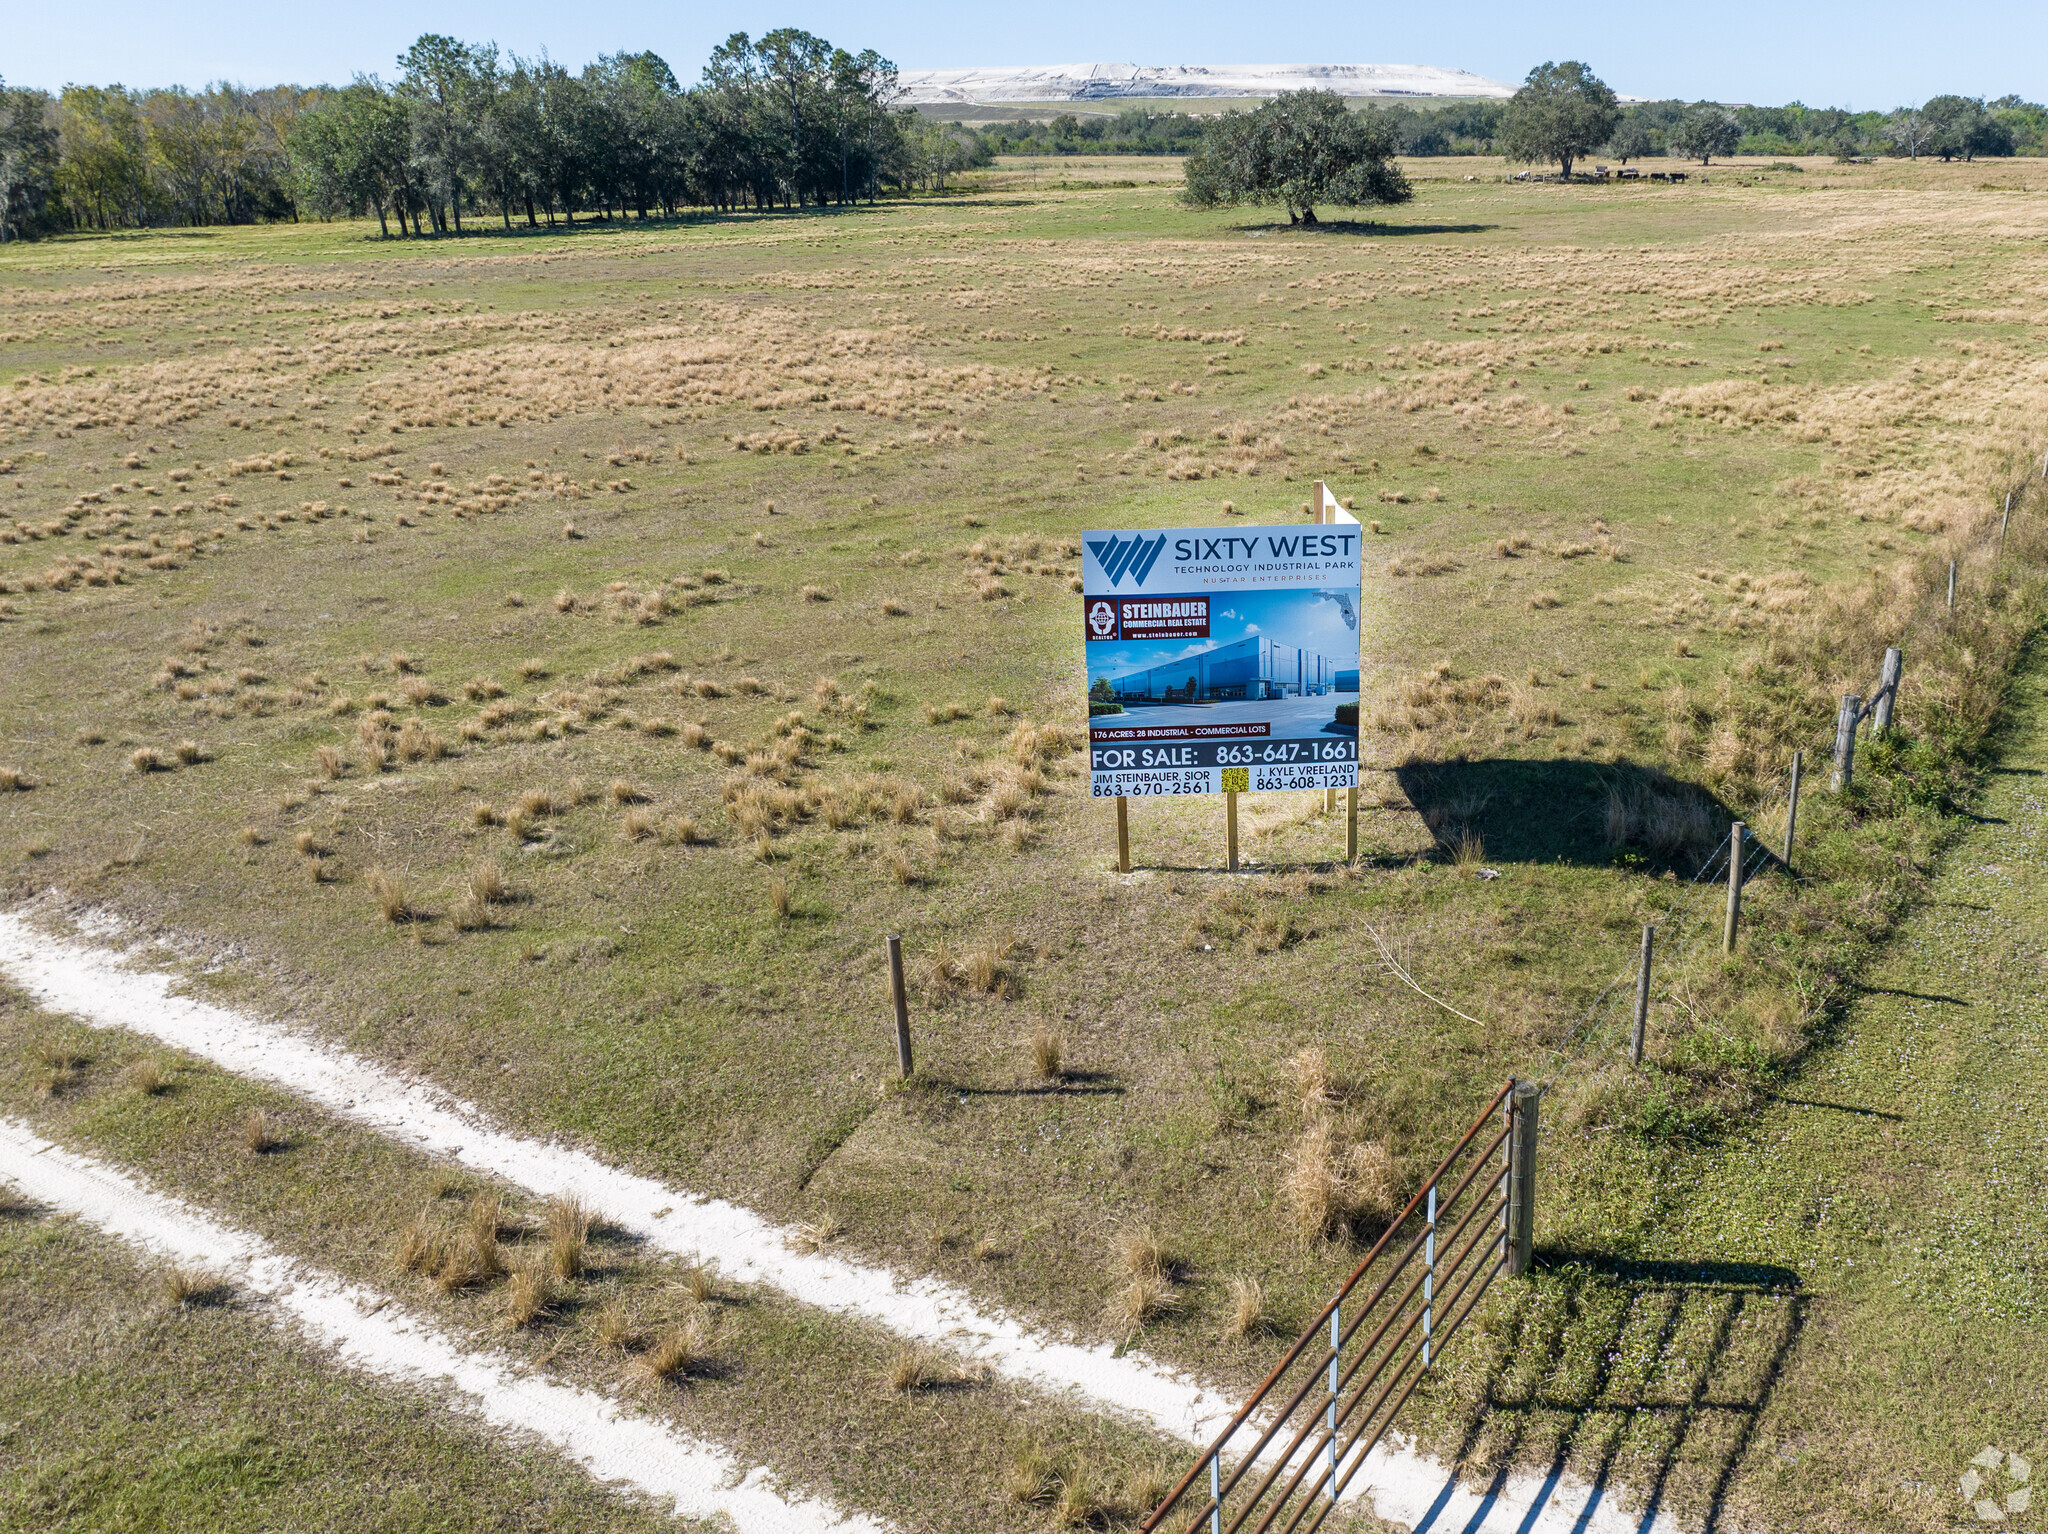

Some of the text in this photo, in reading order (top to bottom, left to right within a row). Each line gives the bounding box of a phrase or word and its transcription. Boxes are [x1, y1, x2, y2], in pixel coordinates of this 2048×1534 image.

[1174, 534, 1356, 561] SIXTY WEST
[1174, 561, 1354, 574] TECHNOLOGY INDUSTRIAL PARK
[1203, 574, 1327, 584] NUSTAR ENTERPRISES
[1122, 602, 1207, 619] STEINBAUER
[1123, 618, 1207, 629] COMMERCIAL REAL ESTATE
[1132, 631, 1198, 639] www.steinbauer.com
[1094, 731, 1107, 739] 176
[1108, 730, 1136, 738] ACRES:
[1147, 728, 1189, 737] INDUSTRIAL
[1195, 726, 1248, 736] COMMERCIAL
[1248, 725, 1266, 734] LOTS
[1092, 741, 1356, 768] FOR SALE: 863-647-1661
[1093, 770, 1210, 784] JIM STEINBAUER, SIOR
[1256, 764, 1355, 777] J. KYLE VREELAND
[1093, 781, 1210, 797] 863-670-2561
[1256, 775, 1354, 791] 863-608-1231
